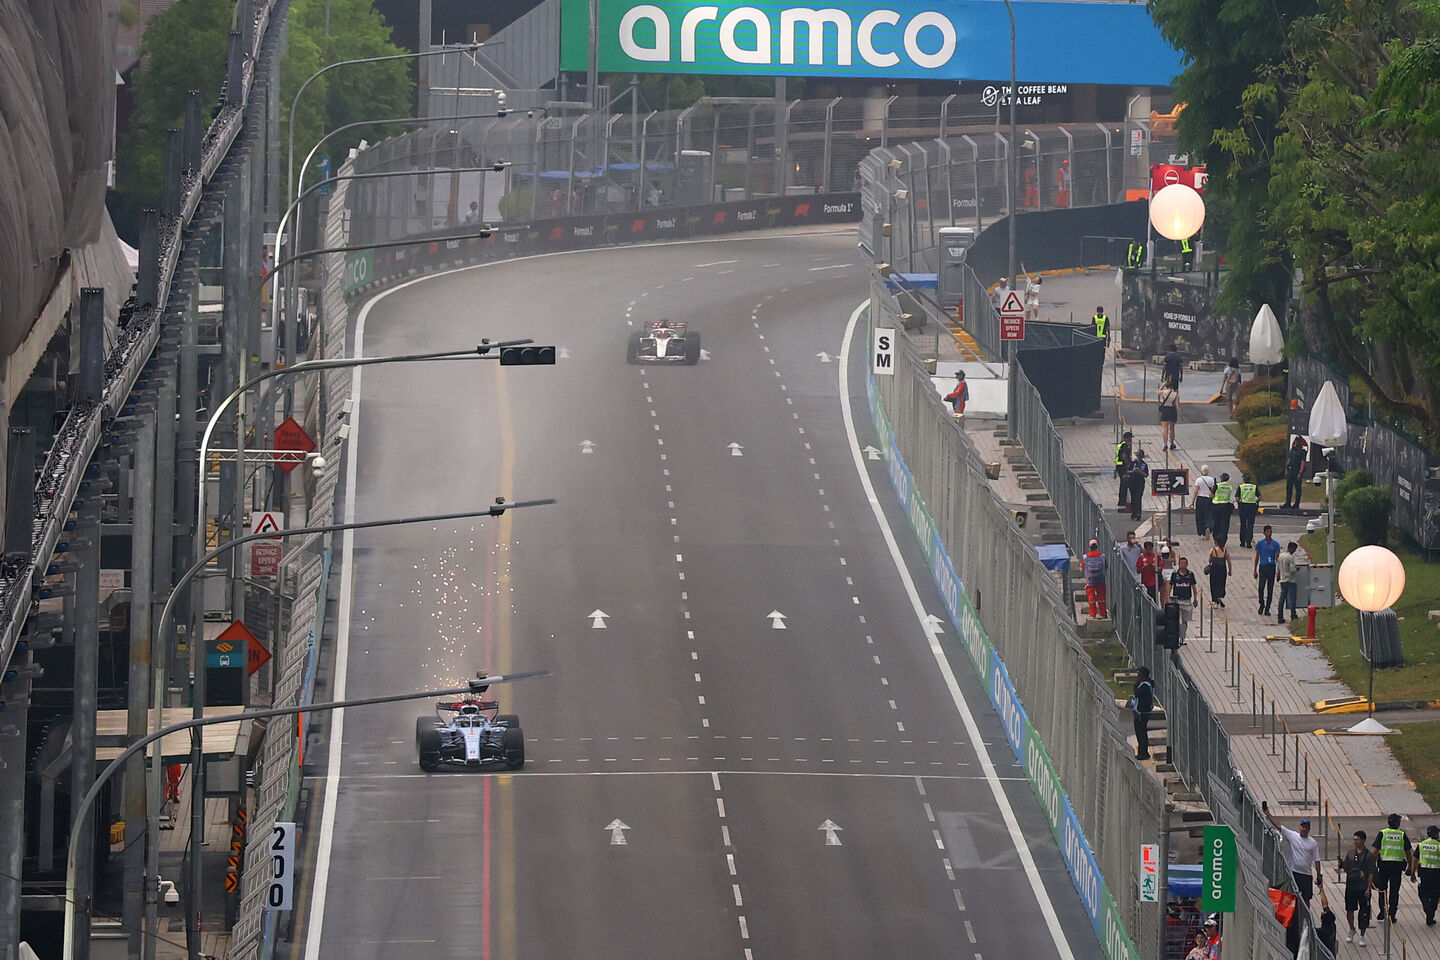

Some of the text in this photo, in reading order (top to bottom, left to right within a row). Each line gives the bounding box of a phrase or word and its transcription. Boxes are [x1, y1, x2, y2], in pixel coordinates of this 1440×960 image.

[618, 5, 957, 69] aramco
[1007, 97, 1022, 105] TA
[1023, 96, 1042, 105] LEAF
[1018, 85, 1046, 94] COFFEE
[1047, 85, 1067, 94] BEAN
[823, 203, 847, 214] Formula
[255, 548, 278, 556] REDUCE
[962, 604, 987, 680] aramco
[994, 666, 1021, 750] aramco
[1028, 738, 1058, 828] aramco
[1065, 817, 1098, 919] aramco
[1211, 838, 1223, 900] aramco
